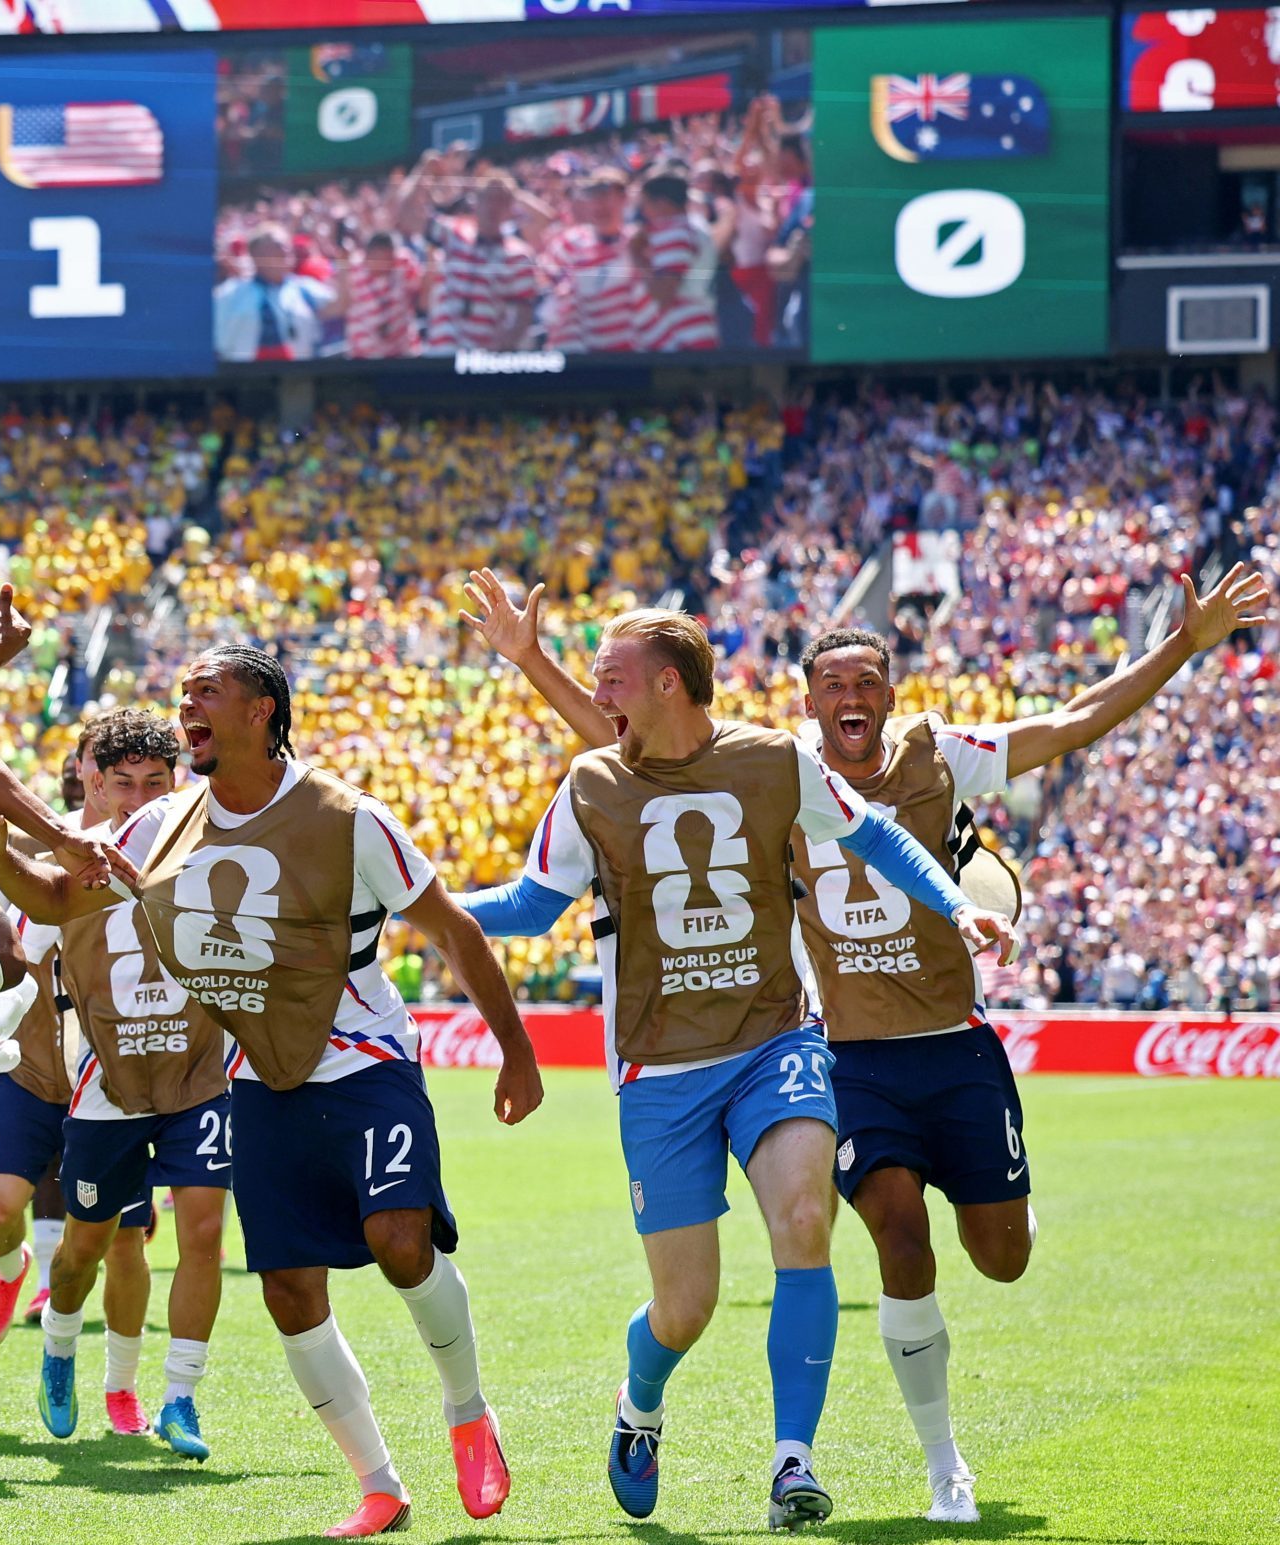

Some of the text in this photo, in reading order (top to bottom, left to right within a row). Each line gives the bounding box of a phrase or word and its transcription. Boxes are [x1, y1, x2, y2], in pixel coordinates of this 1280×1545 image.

[29, 216, 126, 318] 1
[454, 350, 565, 374] Hisense
[682, 914, 730, 934] FIFA
[845, 907, 888, 926] FIFA
[200, 942, 246, 960] FIFA
[830, 941, 882, 956] WORD
[885, 936, 916, 953] CUP
[661, 947, 758, 971] WORLD CUP
[836, 952, 921, 974] 2026
[176, 975, 269, 991] WORLD CUP
[661, 964, 760, 996] 2026
[134, 989, 169, 1005] FIFA
[116, 1020, 189, 1036] WORD CUP
[778, 1053, 826, 1094] 25
[1005, 1108, 1020, 1160] 6
[364, 1123, 413, 1181] 12
[837, 1141, 852, 1157] USA
[78, 1183, 96, 1194] USA
